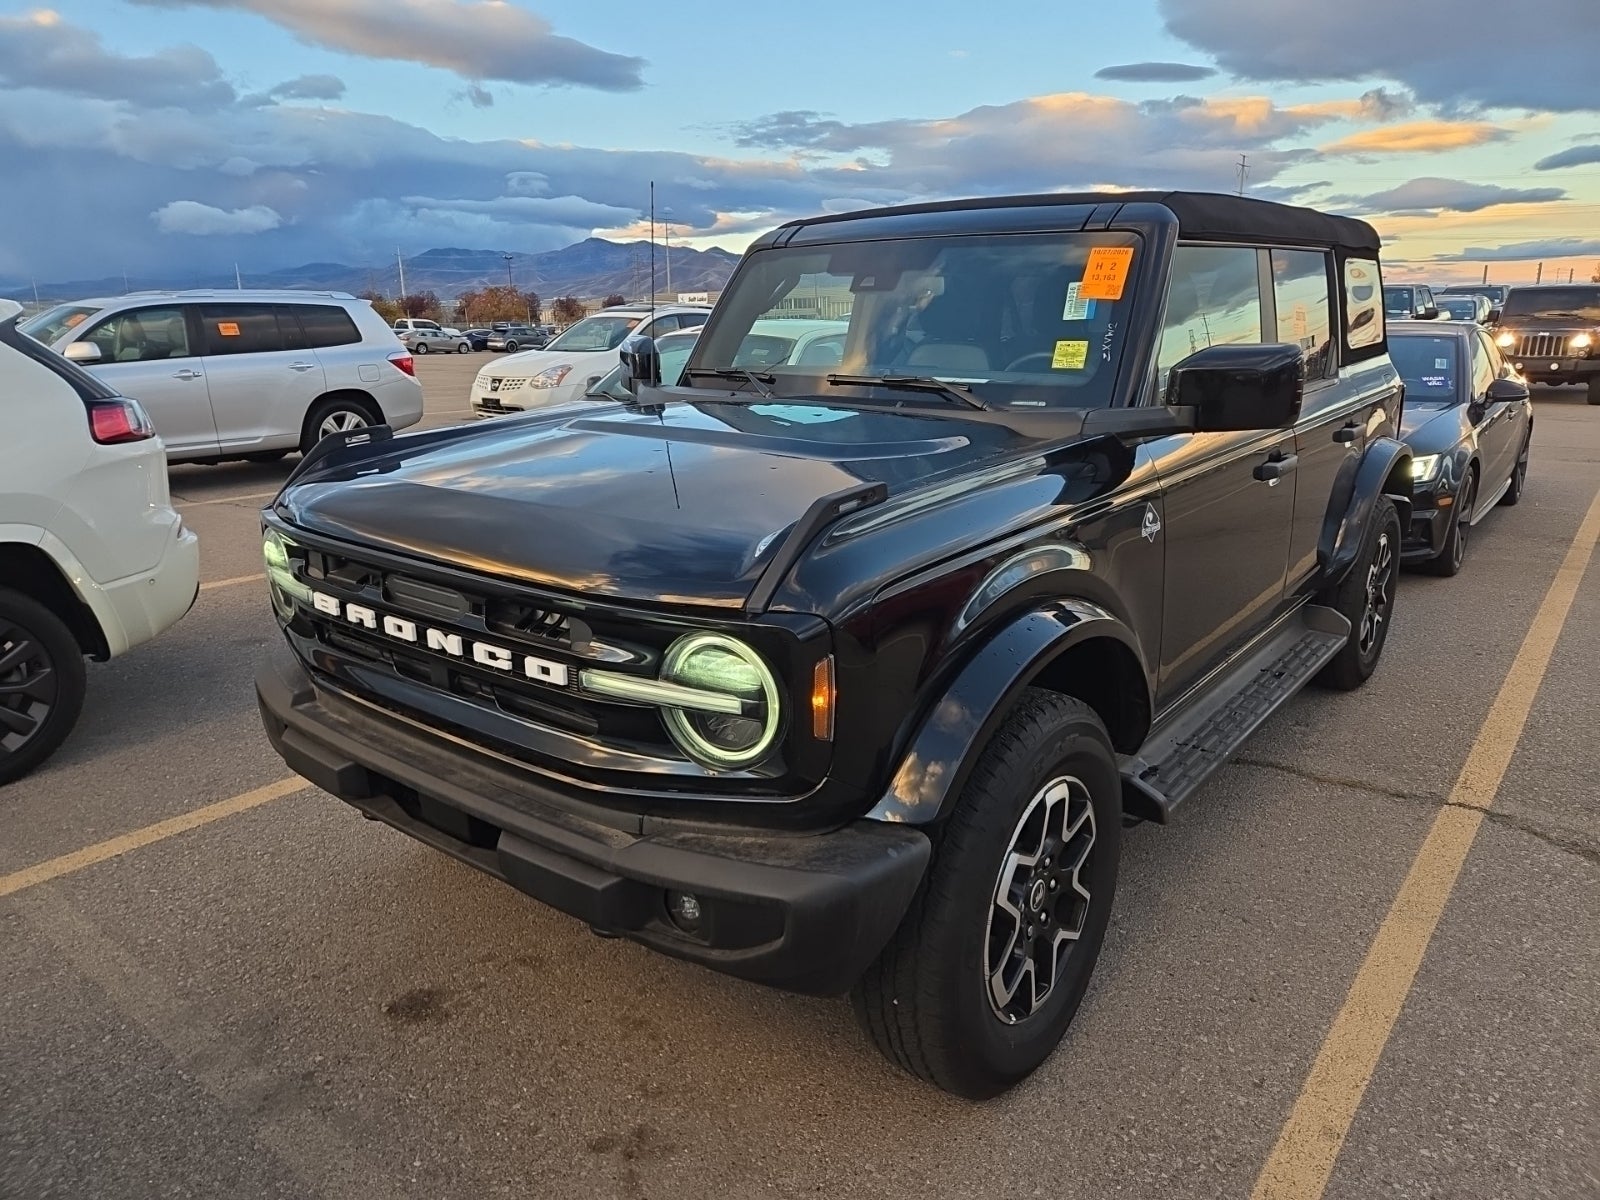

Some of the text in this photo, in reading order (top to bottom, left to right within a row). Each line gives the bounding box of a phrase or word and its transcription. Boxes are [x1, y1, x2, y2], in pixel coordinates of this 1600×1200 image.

[1095, 262, 1117, 270] H 2
[313, 591, 569, 686] BRONCO
